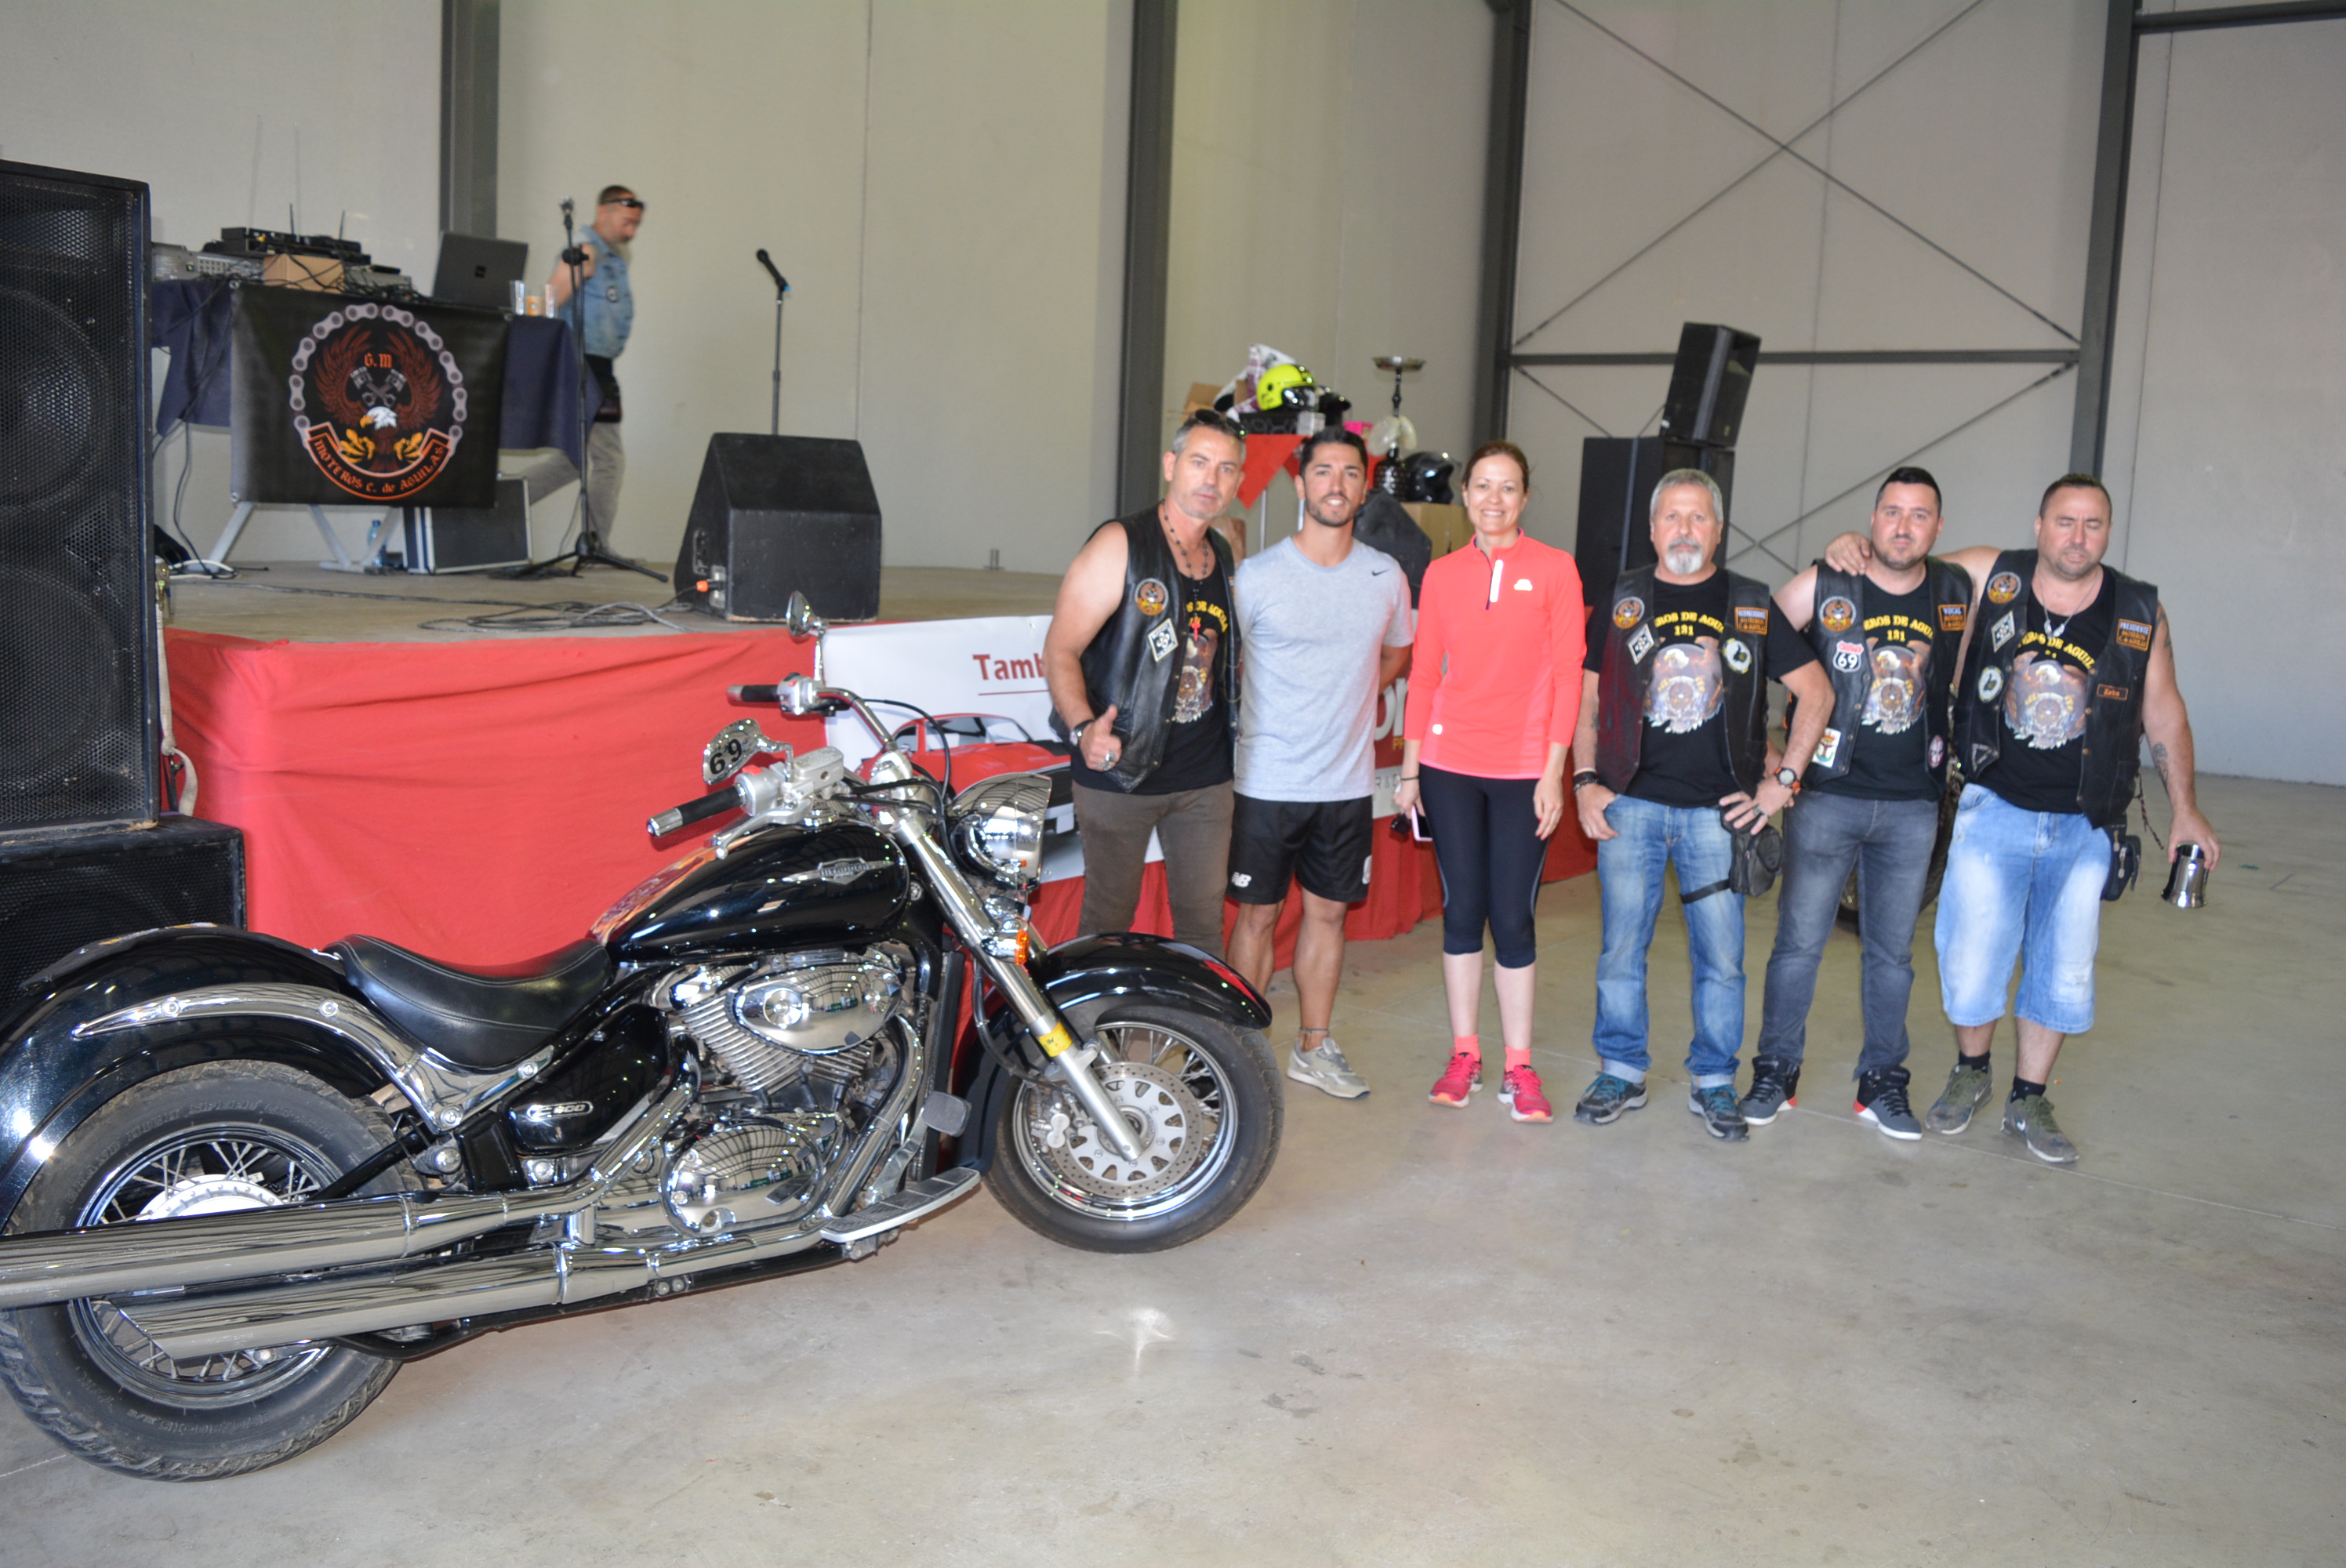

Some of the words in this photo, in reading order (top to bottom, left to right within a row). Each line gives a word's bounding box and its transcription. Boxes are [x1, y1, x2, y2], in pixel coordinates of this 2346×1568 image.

[314, 438, 363, 489] MOTEROS
[382, 482, 396, 493] de
[1680, 612, 1698, 622] DE
[1892, 615, 1909, 627] DE
[1837, 652, 1858, 669] 69
[710, 739, 742, 775] 69
